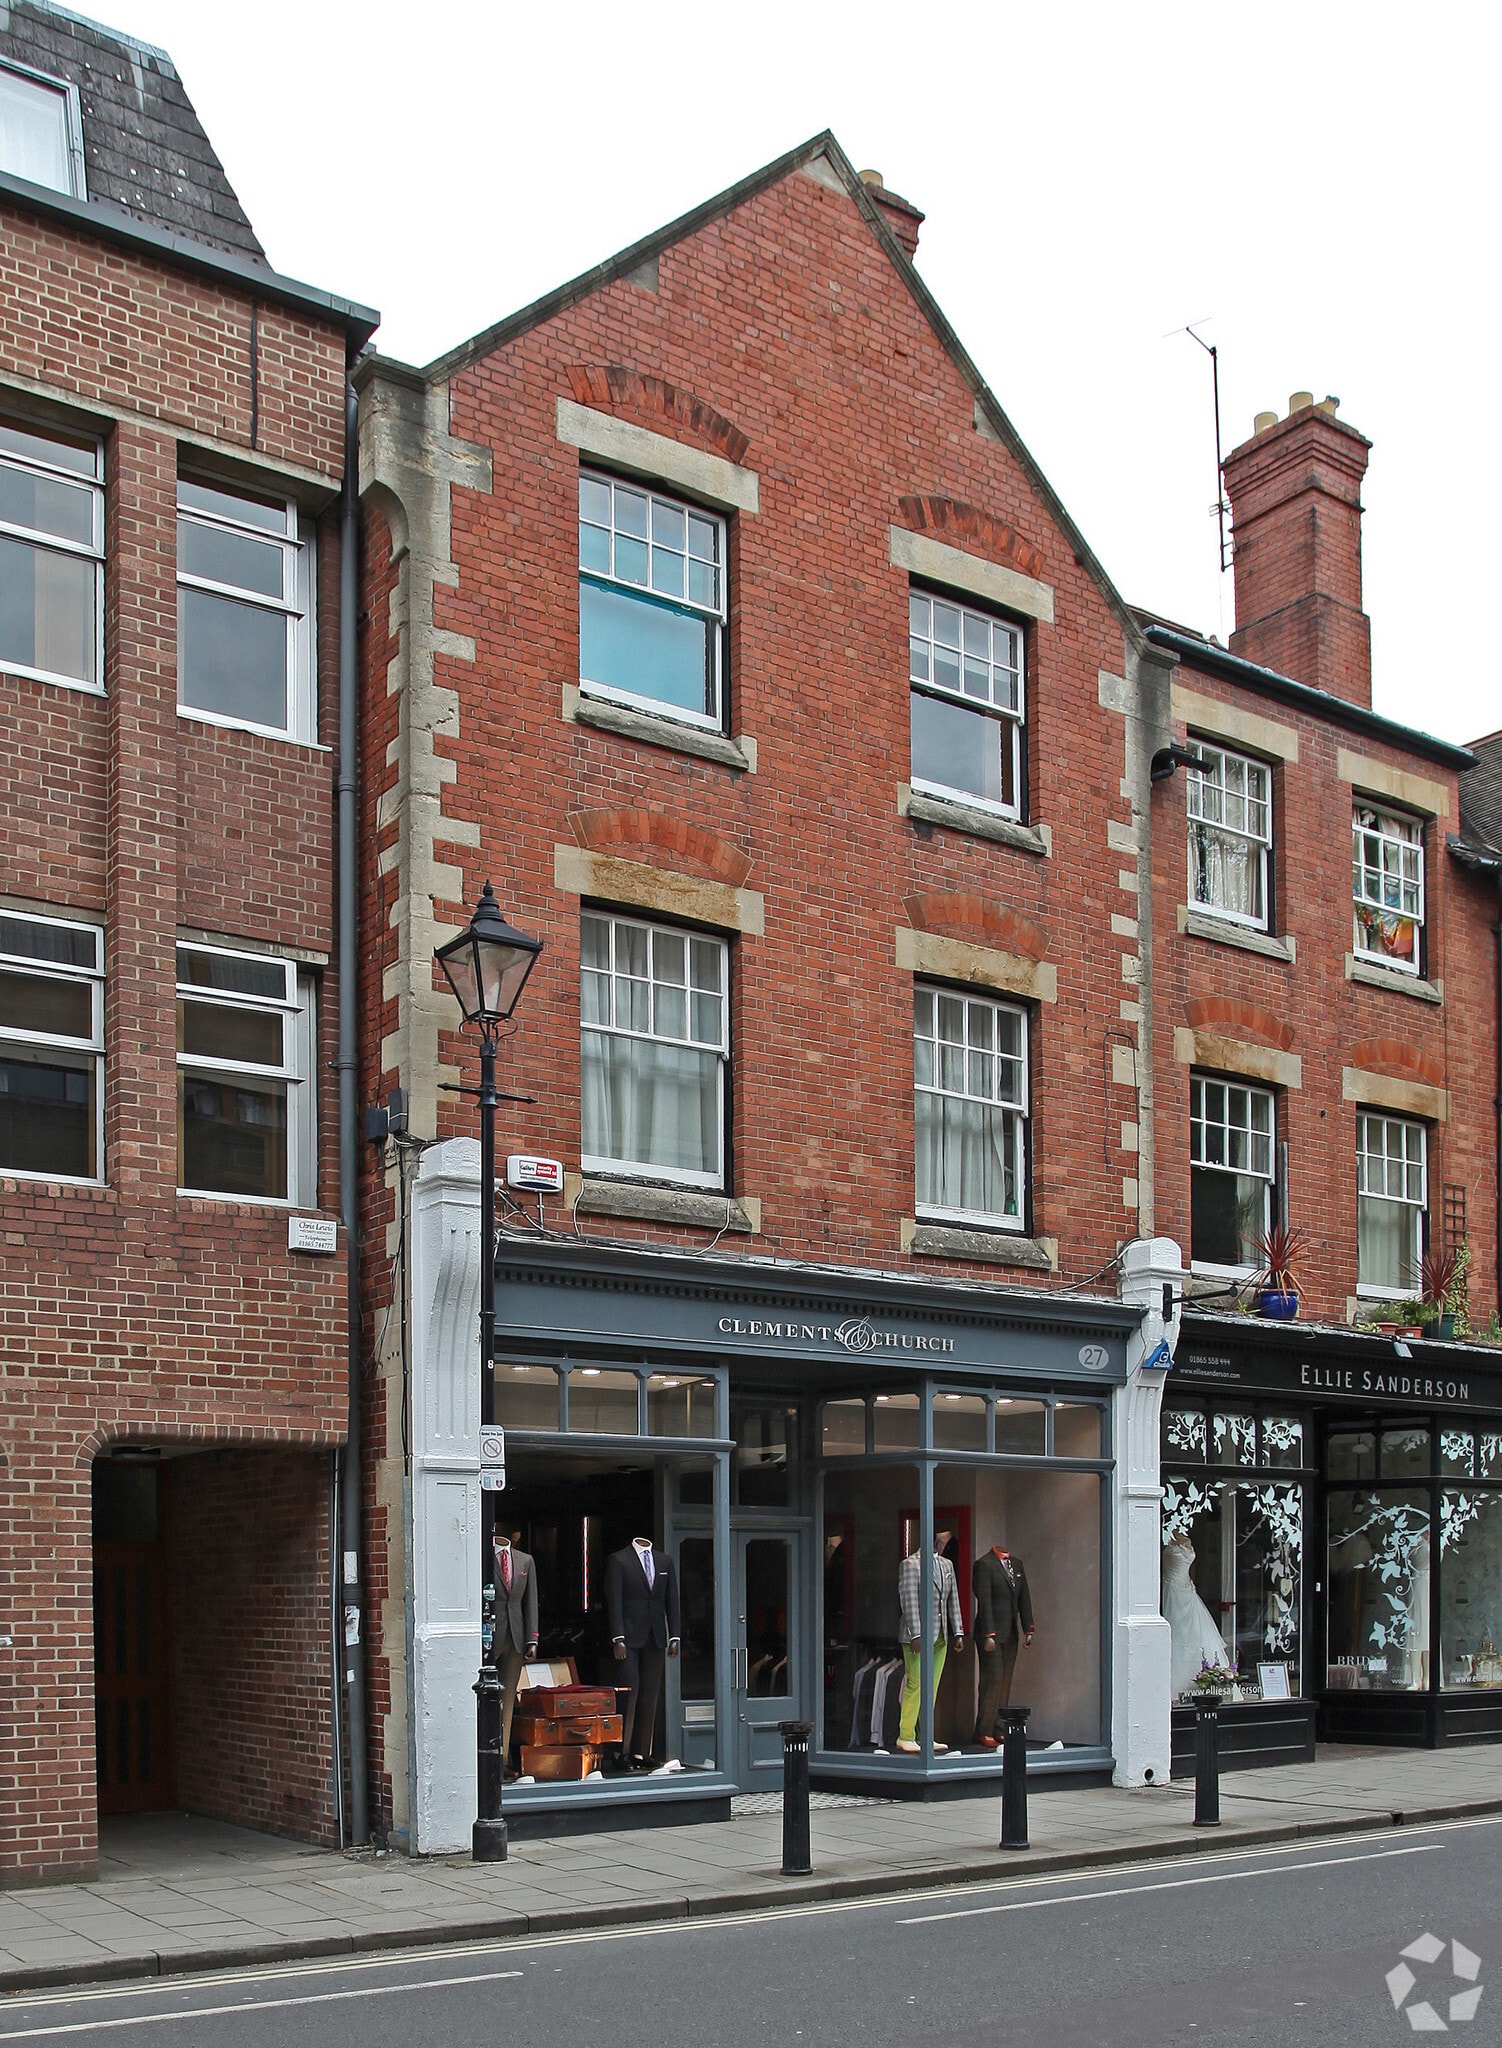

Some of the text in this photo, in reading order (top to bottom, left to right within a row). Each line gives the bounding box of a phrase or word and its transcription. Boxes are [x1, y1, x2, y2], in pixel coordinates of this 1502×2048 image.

[299, 1222, 334, 1232] Chris Lewis
[718, 1316, 846, 1343] CLEMENTS
[871, 1332, 956, 1352] CHURCH
[1084, 1348, 1104, 1366] 27
[1189, 1355, 1208, 1364] 01865
[488, 1360, 494, 1369] 8
[1301, 1364, 1468, 1399] ELLIE SANDERSON
